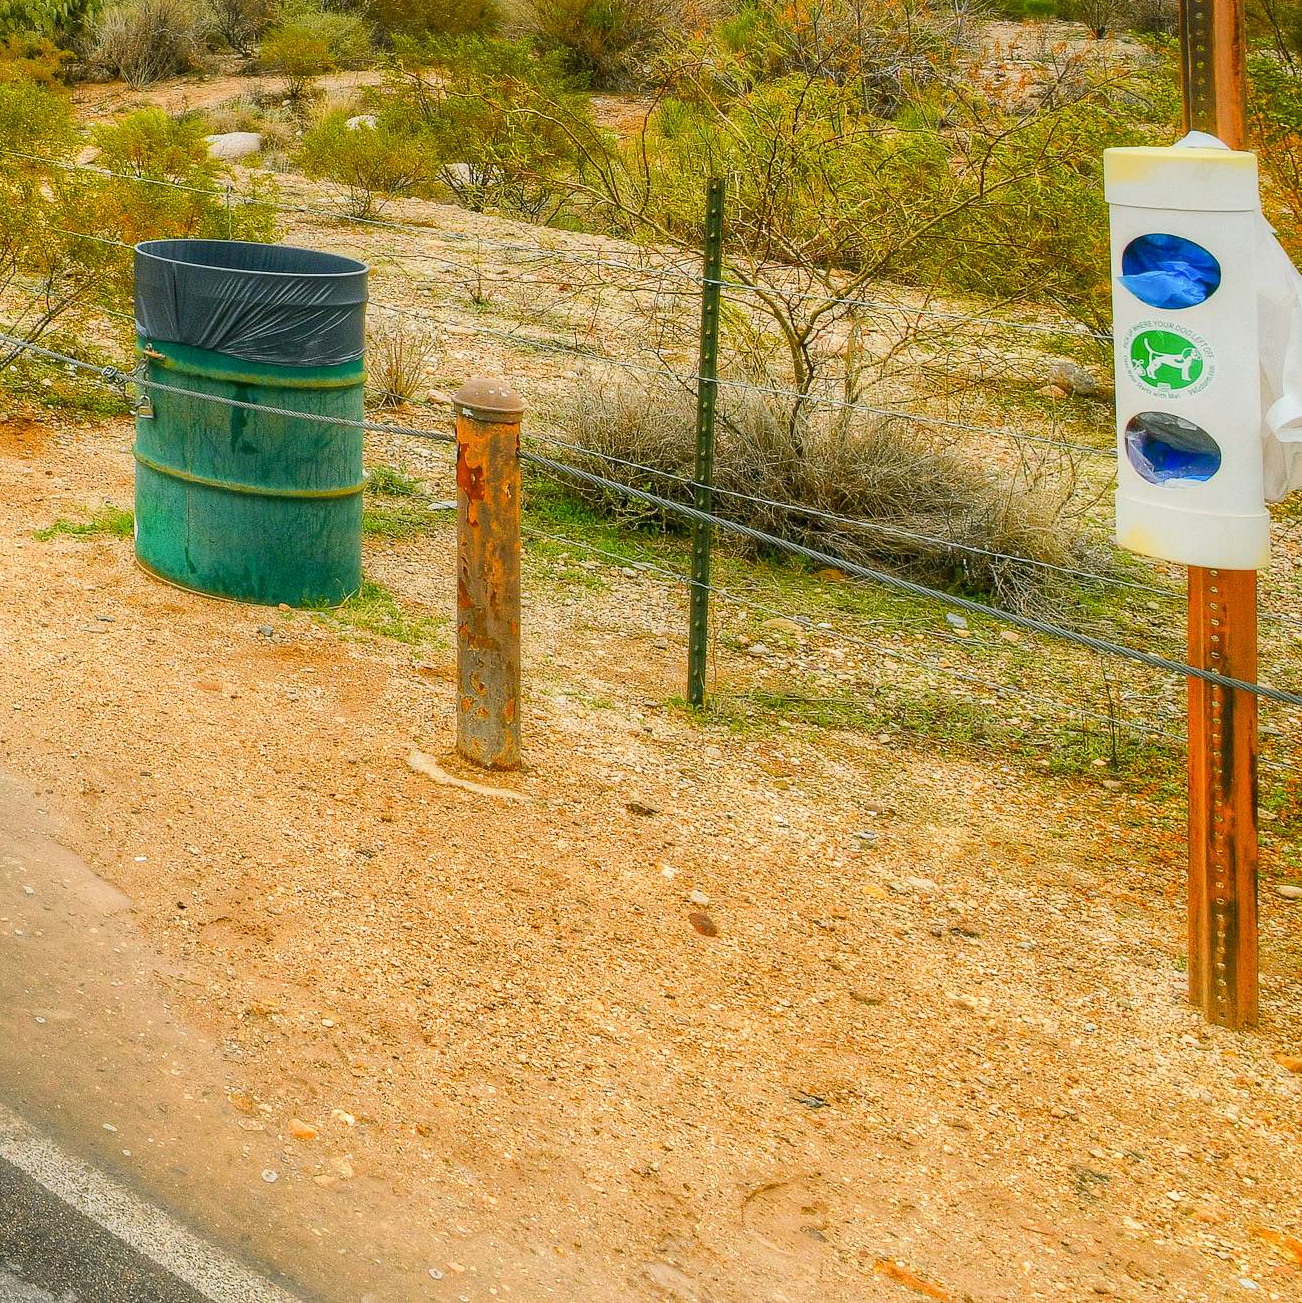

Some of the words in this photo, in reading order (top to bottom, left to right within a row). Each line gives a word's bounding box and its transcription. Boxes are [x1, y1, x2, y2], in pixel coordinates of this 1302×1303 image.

[1132, 320, 1152, 331] WHERE
[1154, 321, 1175, 330] YOUR
[1175, 324, 1192, 336] DOG
[1191, 332, 1208, 347] LEFT
[1204, 345, 1215, 358] OFF
